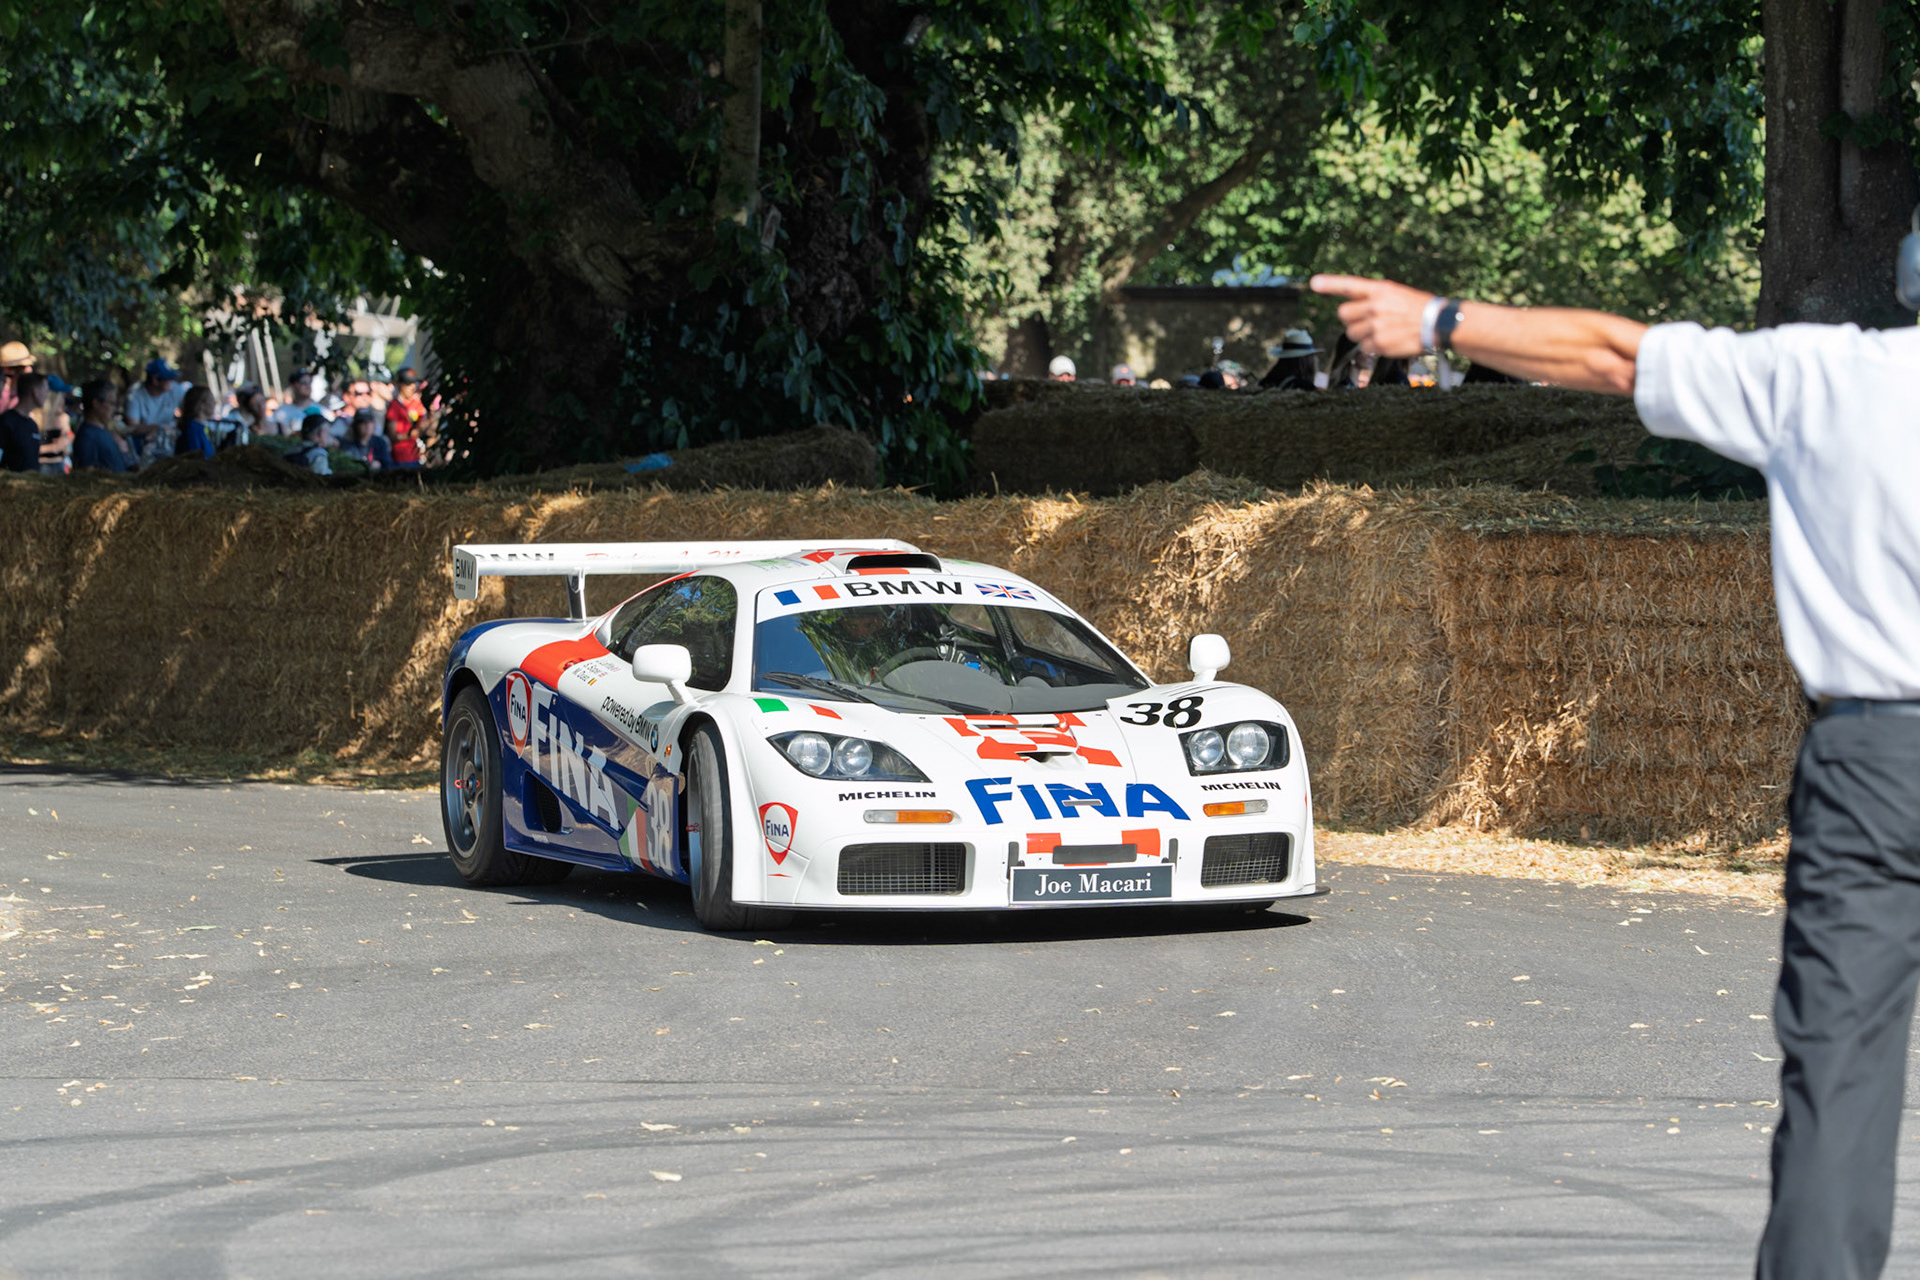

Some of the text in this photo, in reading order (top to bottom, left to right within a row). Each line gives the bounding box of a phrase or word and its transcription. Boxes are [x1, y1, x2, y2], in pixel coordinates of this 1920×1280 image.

[456, 558, 474, 580] BMW
[843, 580, 963, 598] BMW
[510, 693, 527, 723] FINA
[600, 695, 653, 742] powered by BMW
[1119, 696, 1204, 729] 38
[531, 682, 620, 831] FINA
[838, 791, 937, 802] MICHELIN
[1200, 781, 1282, 792] MICHELIN
[965, 776, 1192, 826] FINA
[646, 779, 674, 877] 38
[765, 819, 790, 838] FINA
[1034, 872, 1152, 896] Joe Macari
